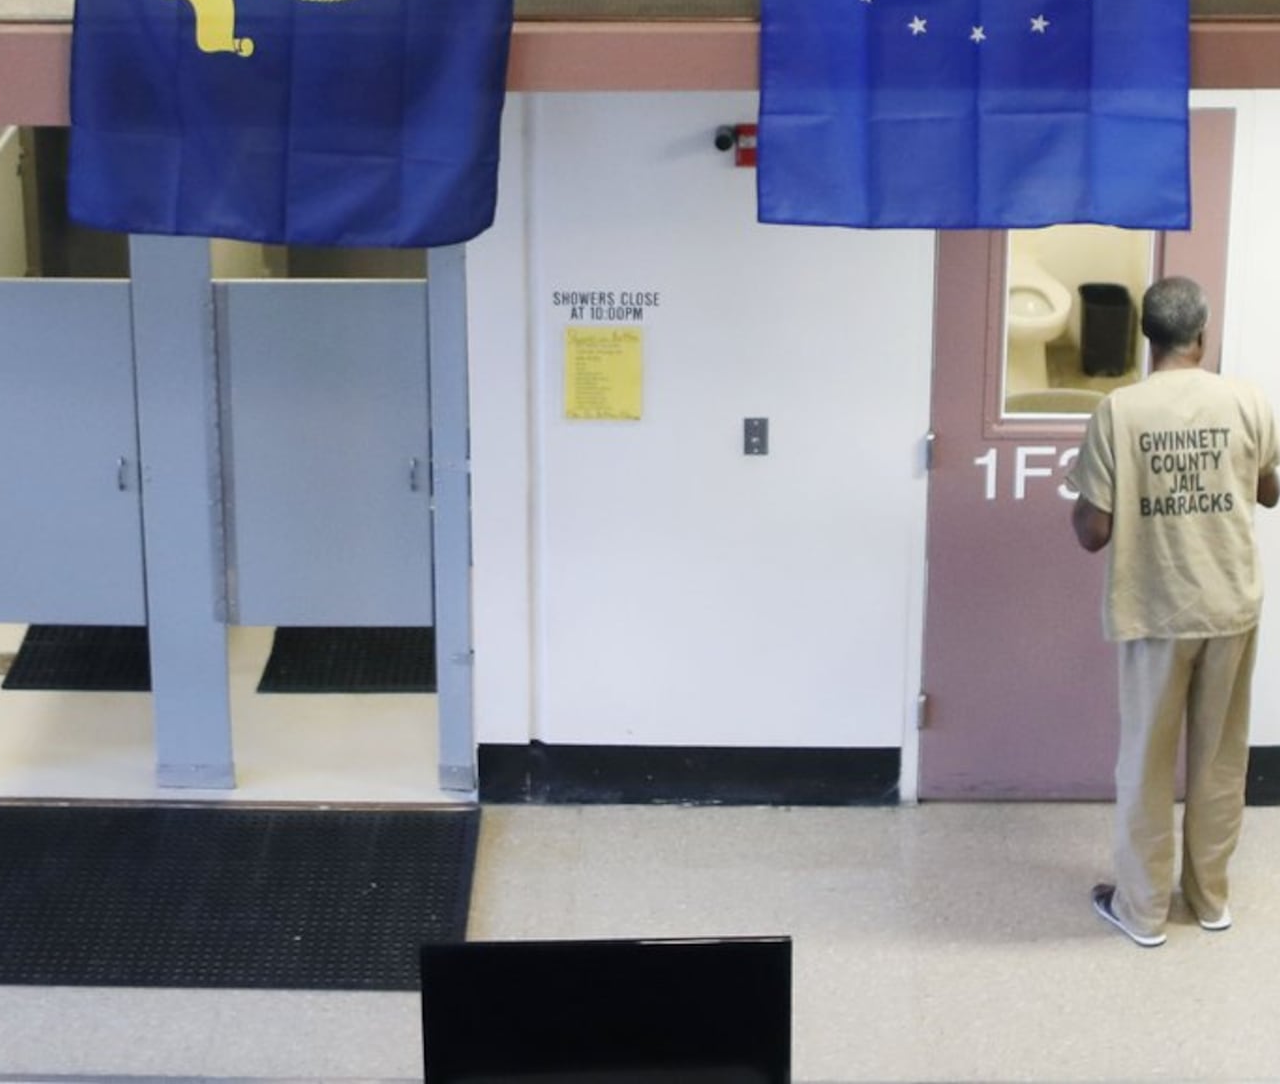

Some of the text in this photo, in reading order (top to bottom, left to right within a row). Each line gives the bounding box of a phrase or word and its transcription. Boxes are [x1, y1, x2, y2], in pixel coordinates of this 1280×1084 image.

[552, 291, 661, 307] SHOWERS CLOSE
[570, 306, 644, 321] AT 10:00PM
[1138, 427, 1232, 454] GWINNETT
[1150, 451, 1222, 475] COUNTY
[1169, 471, 1206, 495] JAIL
[1139, 490, 1234, 516] BARRACKS
